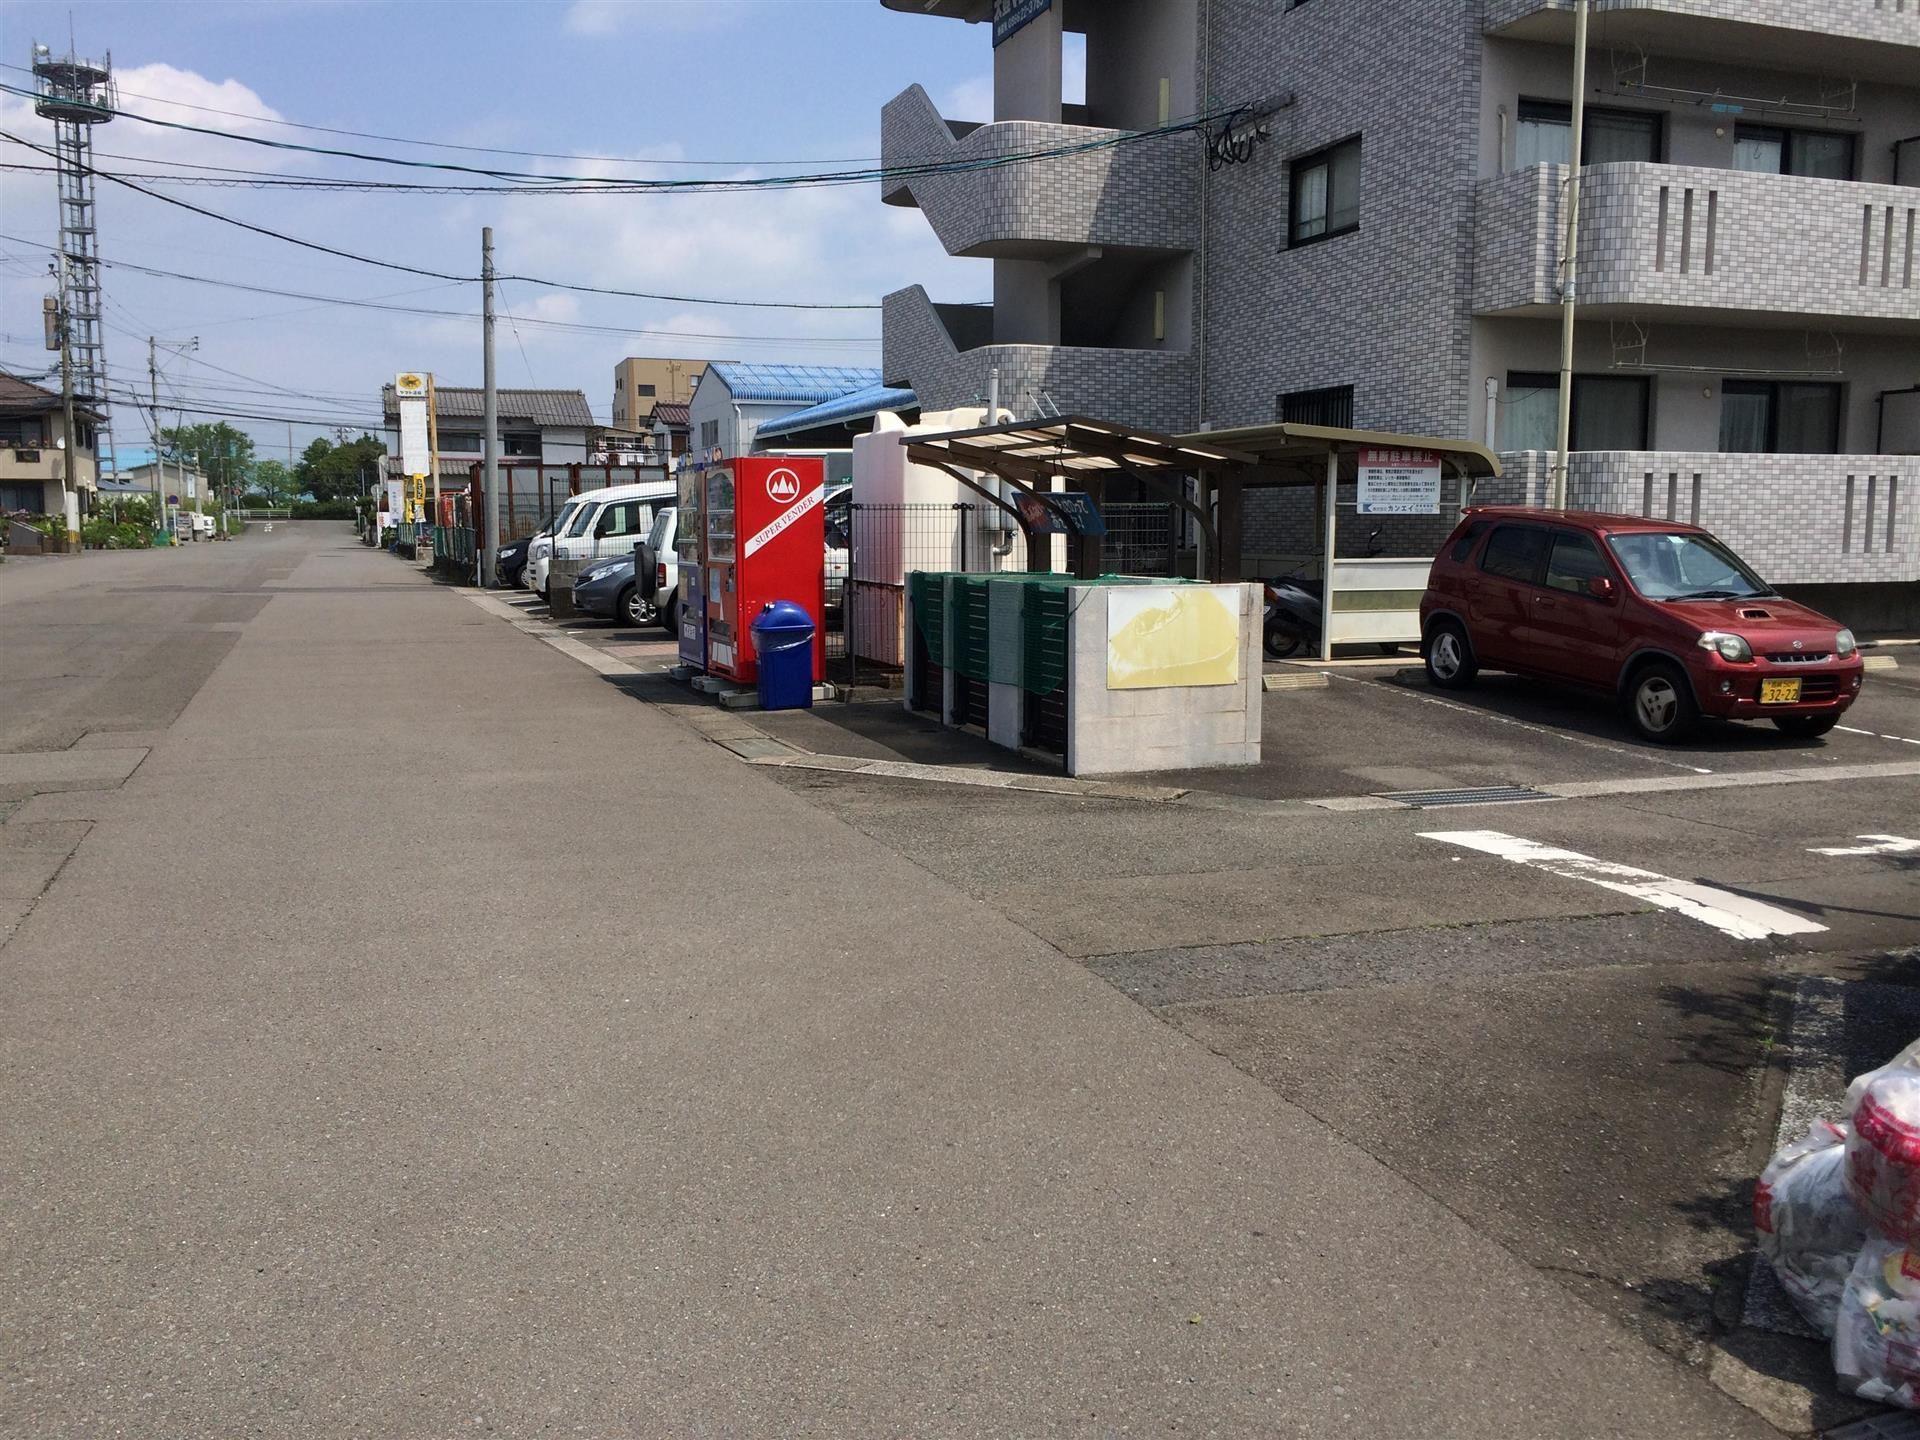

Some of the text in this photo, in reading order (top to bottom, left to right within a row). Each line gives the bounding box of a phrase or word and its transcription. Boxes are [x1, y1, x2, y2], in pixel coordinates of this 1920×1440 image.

[1367, 450, 1433, 463] 無断駐車禁止
[755, 496, 815, 546] SUPER VENDER
[1769, 689, 1798, 701] 32-22
